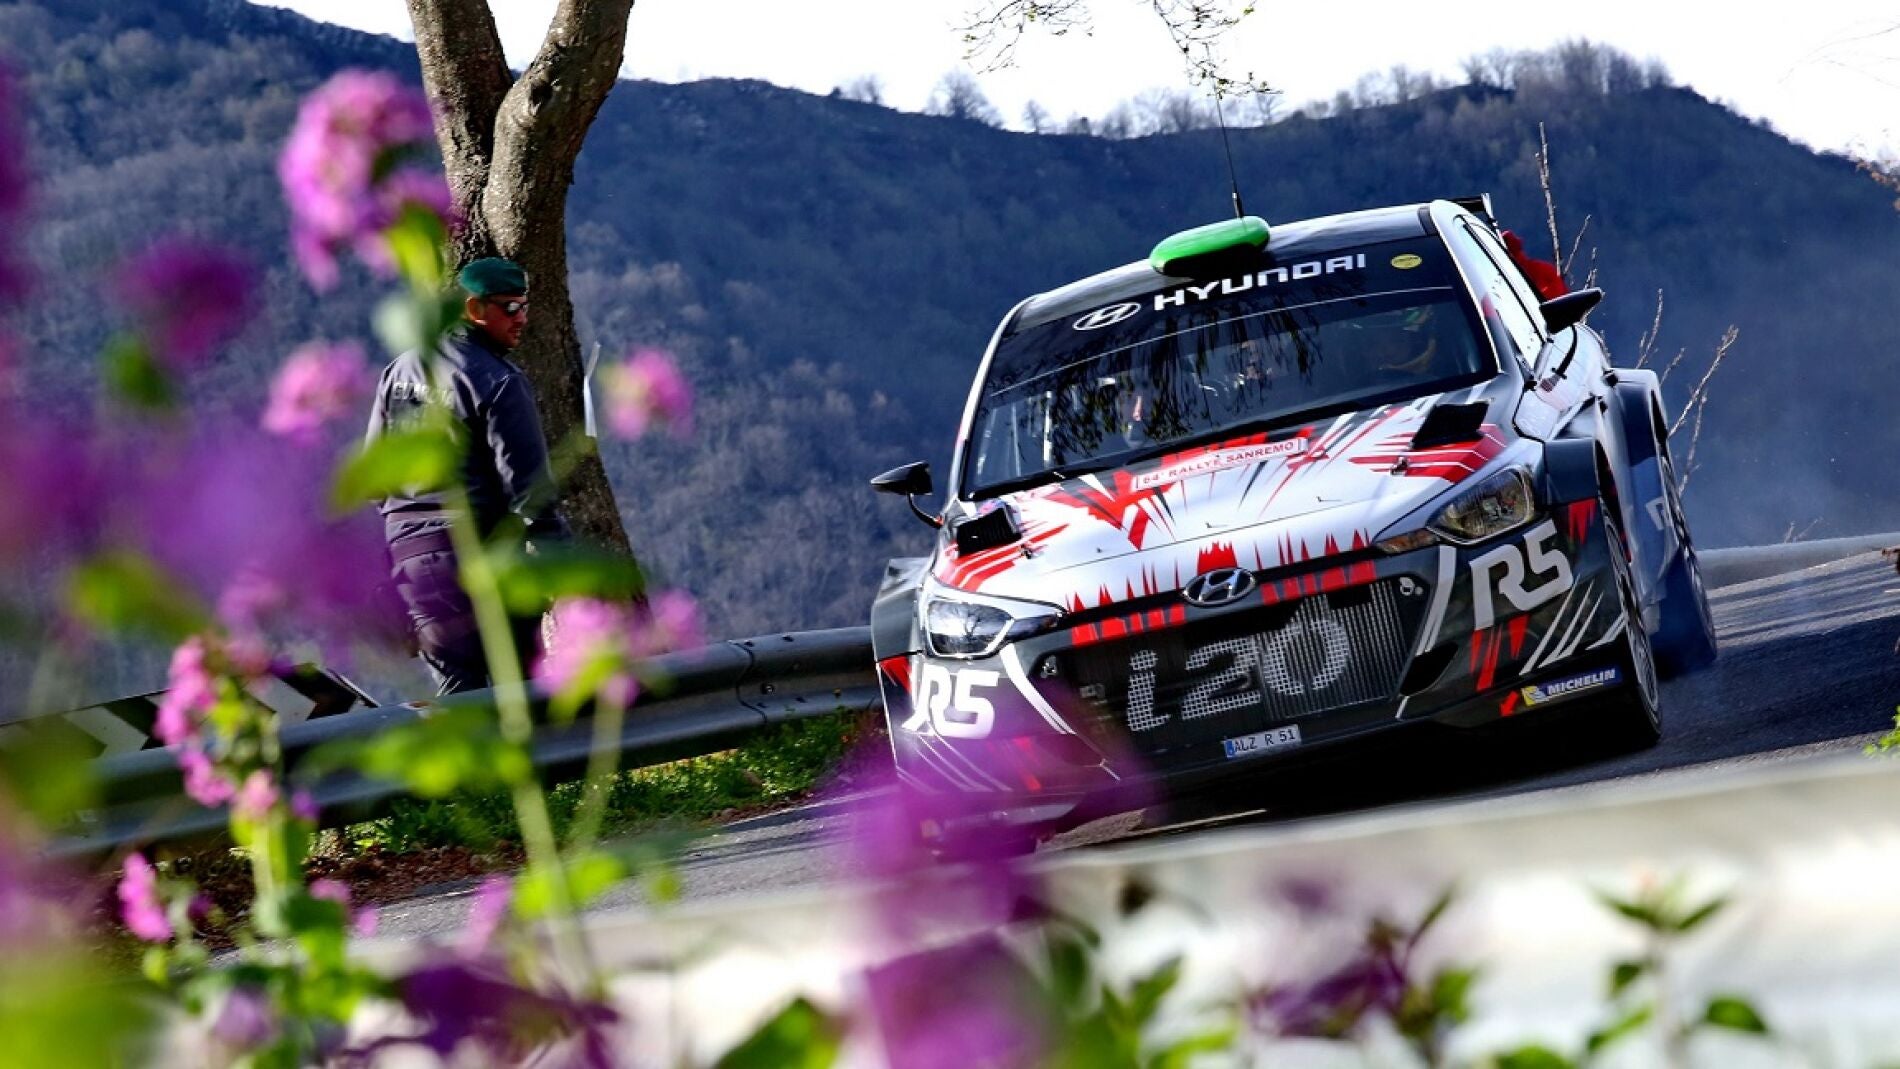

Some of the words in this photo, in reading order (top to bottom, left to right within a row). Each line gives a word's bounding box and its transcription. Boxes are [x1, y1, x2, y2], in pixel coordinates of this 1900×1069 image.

[1154, 254, 1366, 311] HYUNDAI
[1169, 456, 1221, 477] RALLYE
[1226, 441, 1294, 463] SANREMO
[1469, 518, 1574, 631] R5
[902, 662, 1000, 740] R5
[1547, 668, 1616, 695] MICHELIN
[1265, 733, 1275, 746] R
[1280, 729, 1296, 742] 51
